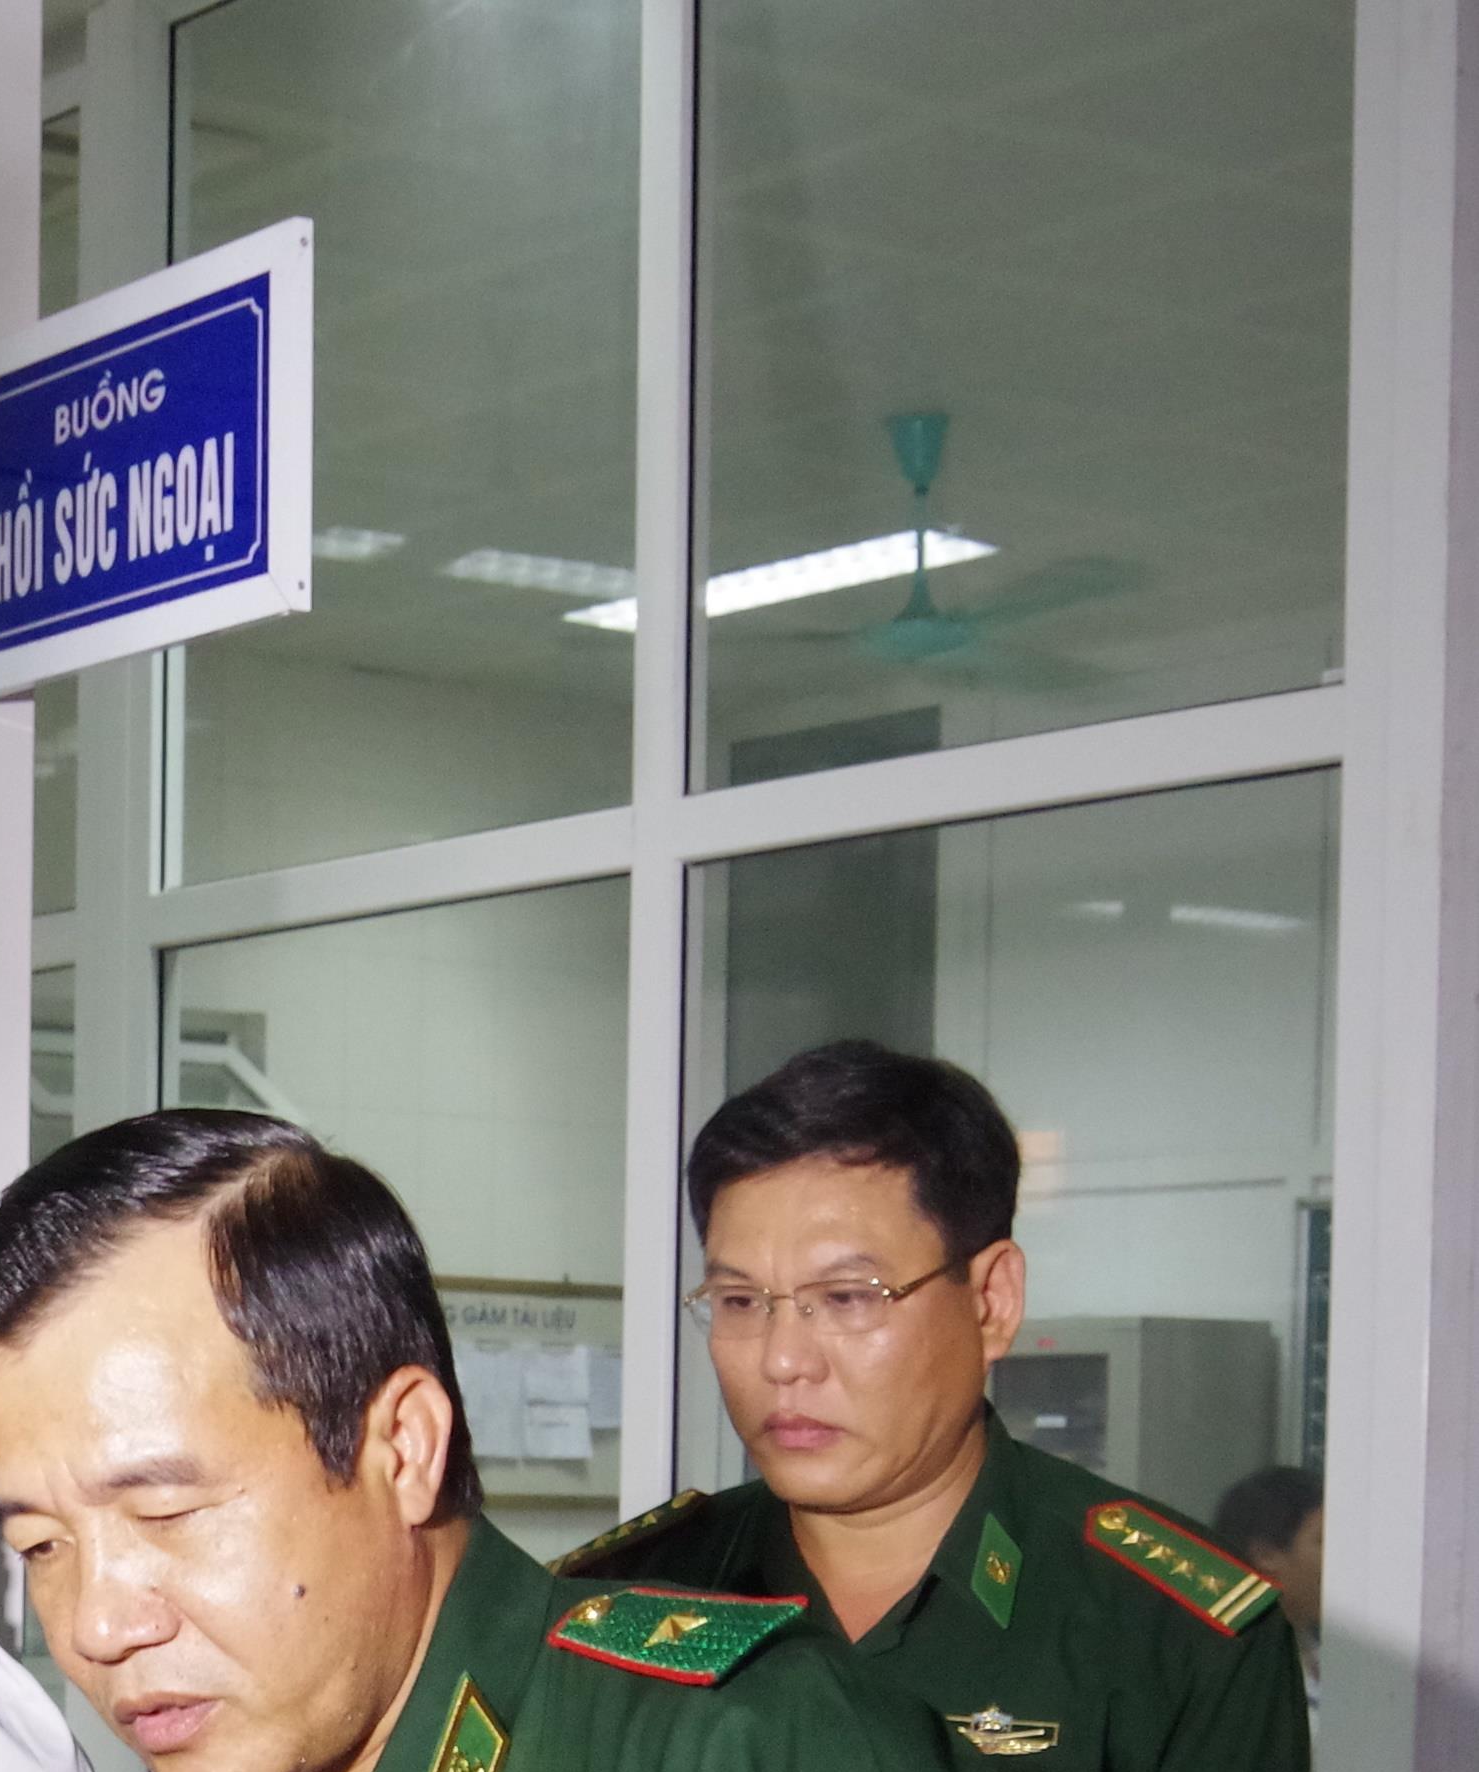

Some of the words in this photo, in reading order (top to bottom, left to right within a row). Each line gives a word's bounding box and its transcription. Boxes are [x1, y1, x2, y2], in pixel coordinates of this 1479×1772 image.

[53, 368, 167, 446] BUỒNG
[53, 451, 118, 585] SỨC
[127, 431, 235, 562] NGOẠI
